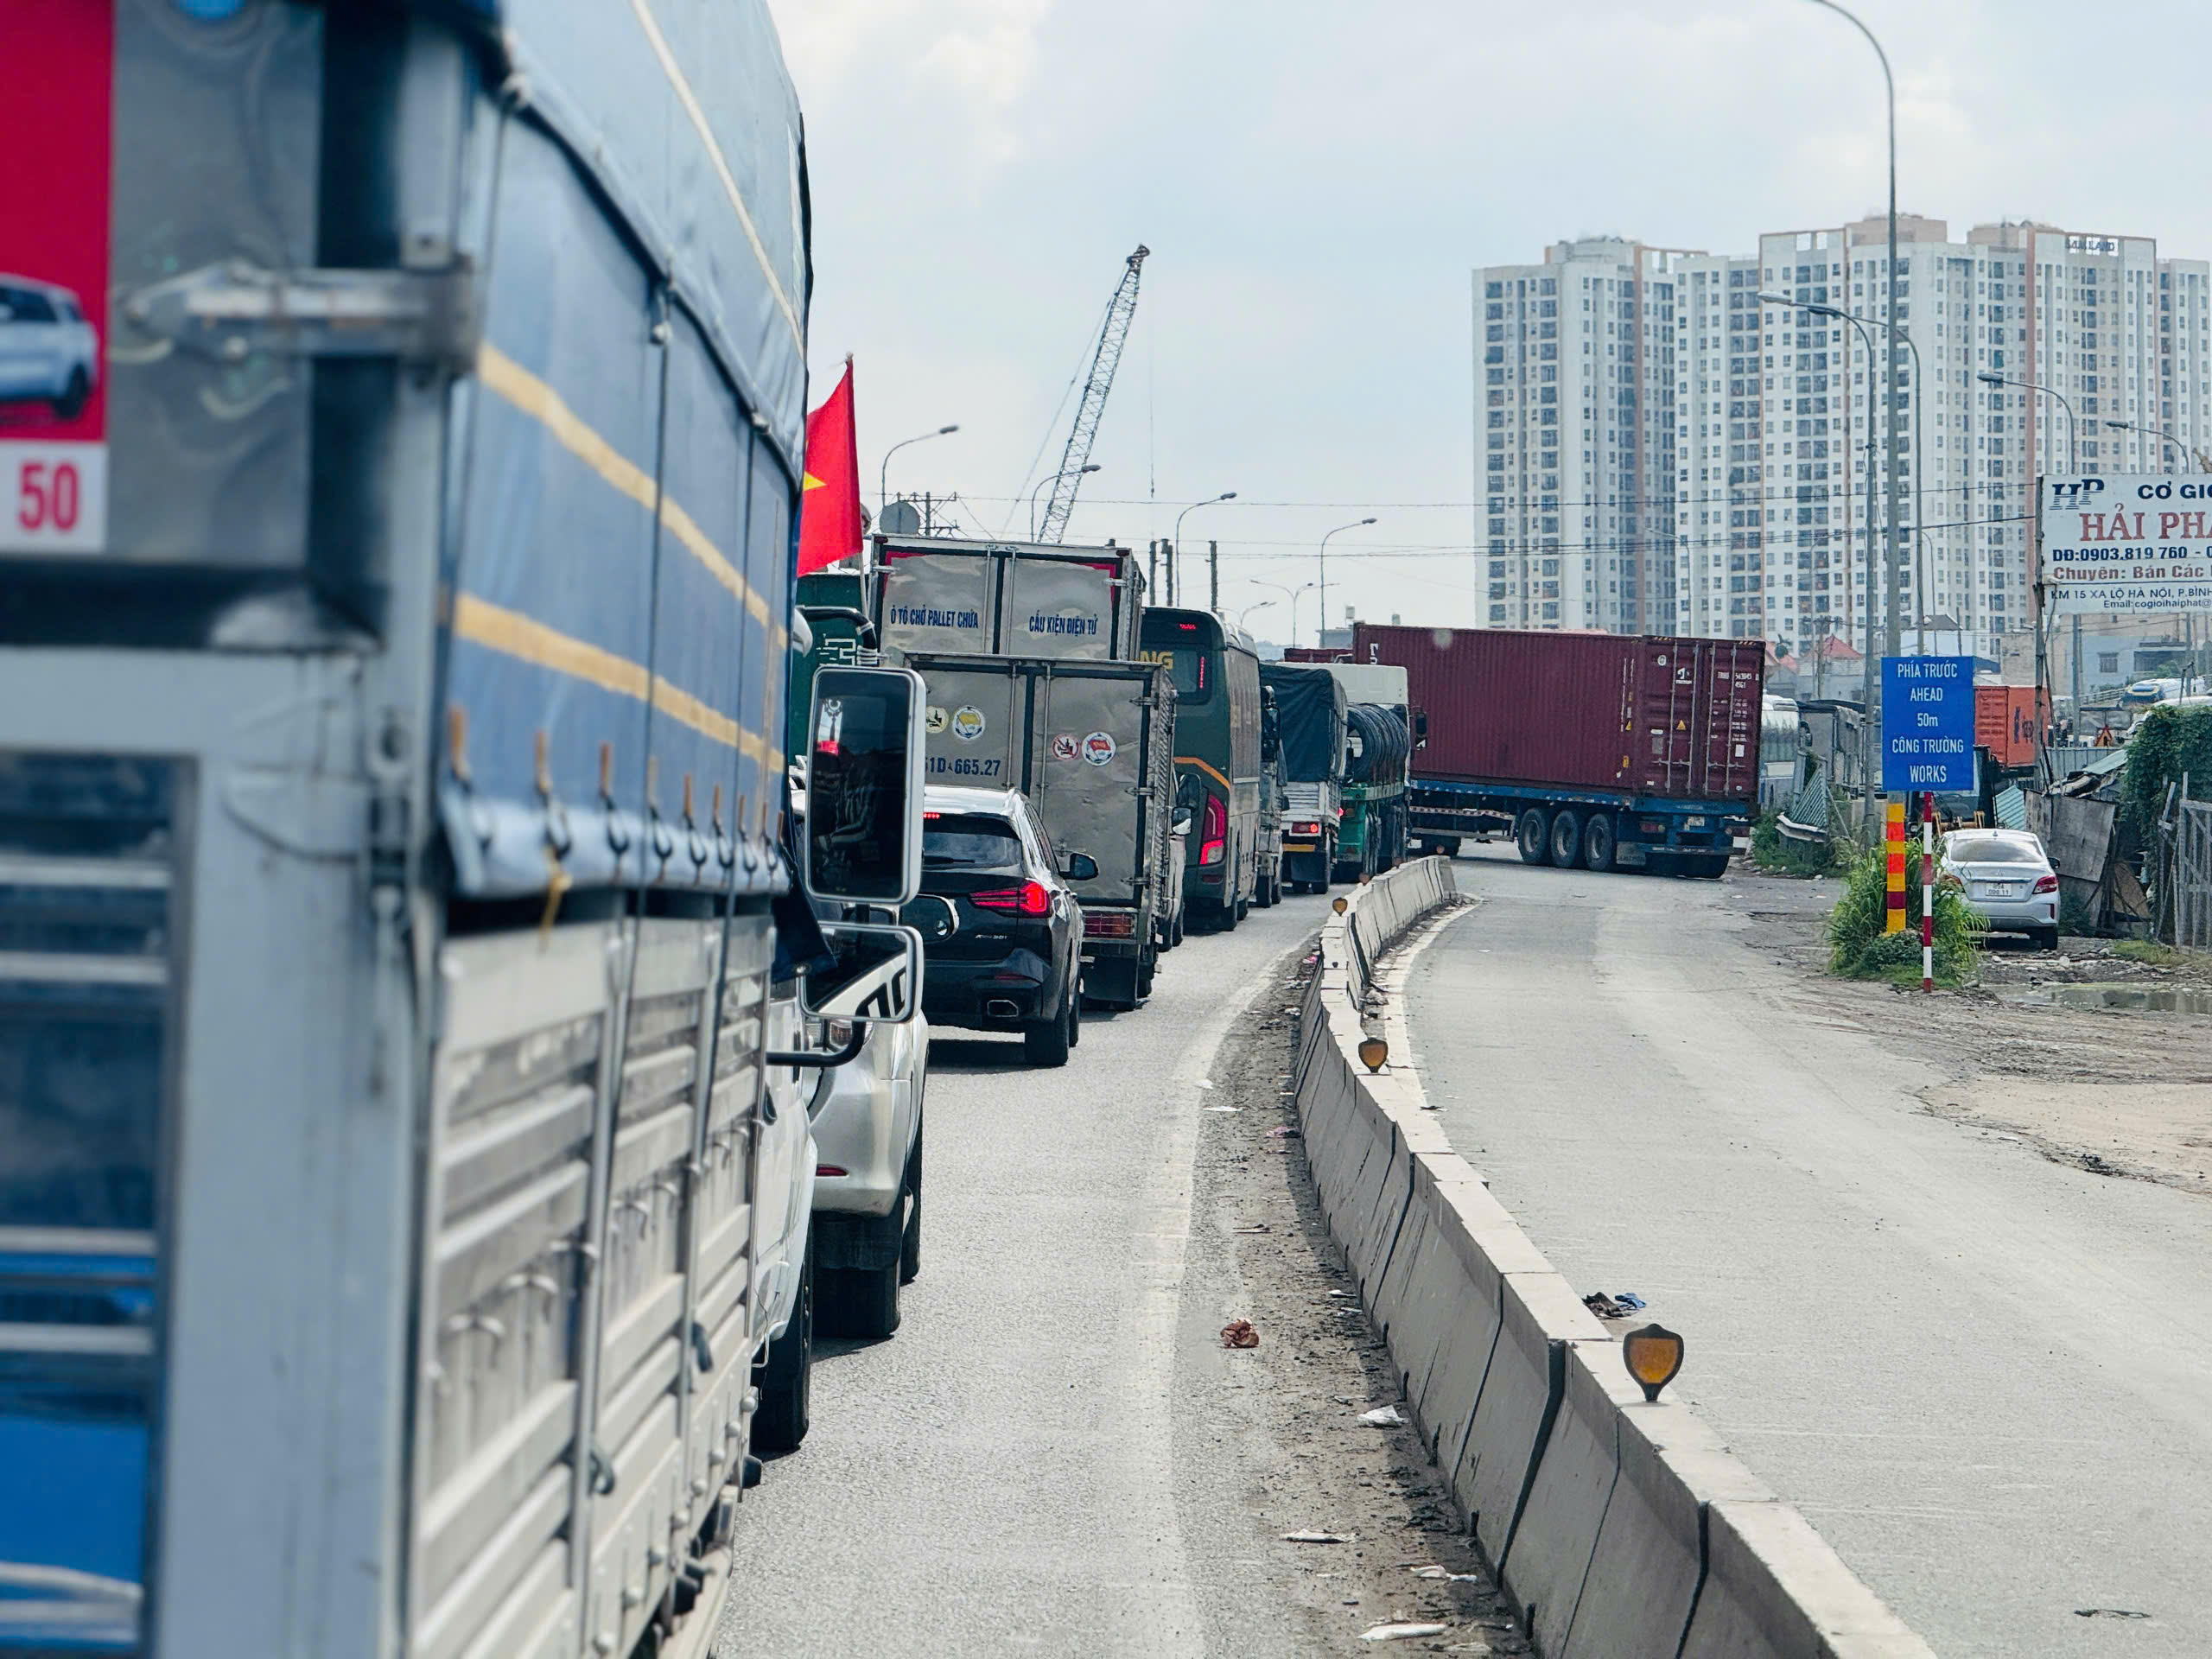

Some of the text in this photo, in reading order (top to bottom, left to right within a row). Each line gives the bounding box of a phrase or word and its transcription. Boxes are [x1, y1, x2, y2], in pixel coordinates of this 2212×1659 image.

[19, 461, 80, 532] 50
[2049, 479, 2105, 510] HP
[2138, 480, 2171, 499] CƠ
[2079, 503, 2212, 542] HẢI PH
[2158, 546, 2188, 559] 760
[2053, 563, 2204, 582] Chuyên: Bán Các
[2050, 590, 2069, 599] KM
[2075, 590, 2087, 599] 15
[2128, 587, 2145, 598] HÀ
[928, 609, 956, 628] PALLET
[1897, 659, 1958, 678] PHÍA TRƯỚC
[1910, 687, 1943, 702] AHEAD
[1917, 712, 1938, 727] 50m
[1892, 735, 1964, 753] CÔNG TRƯỜNG
[1910, 765, 1947, 783] WORKS
